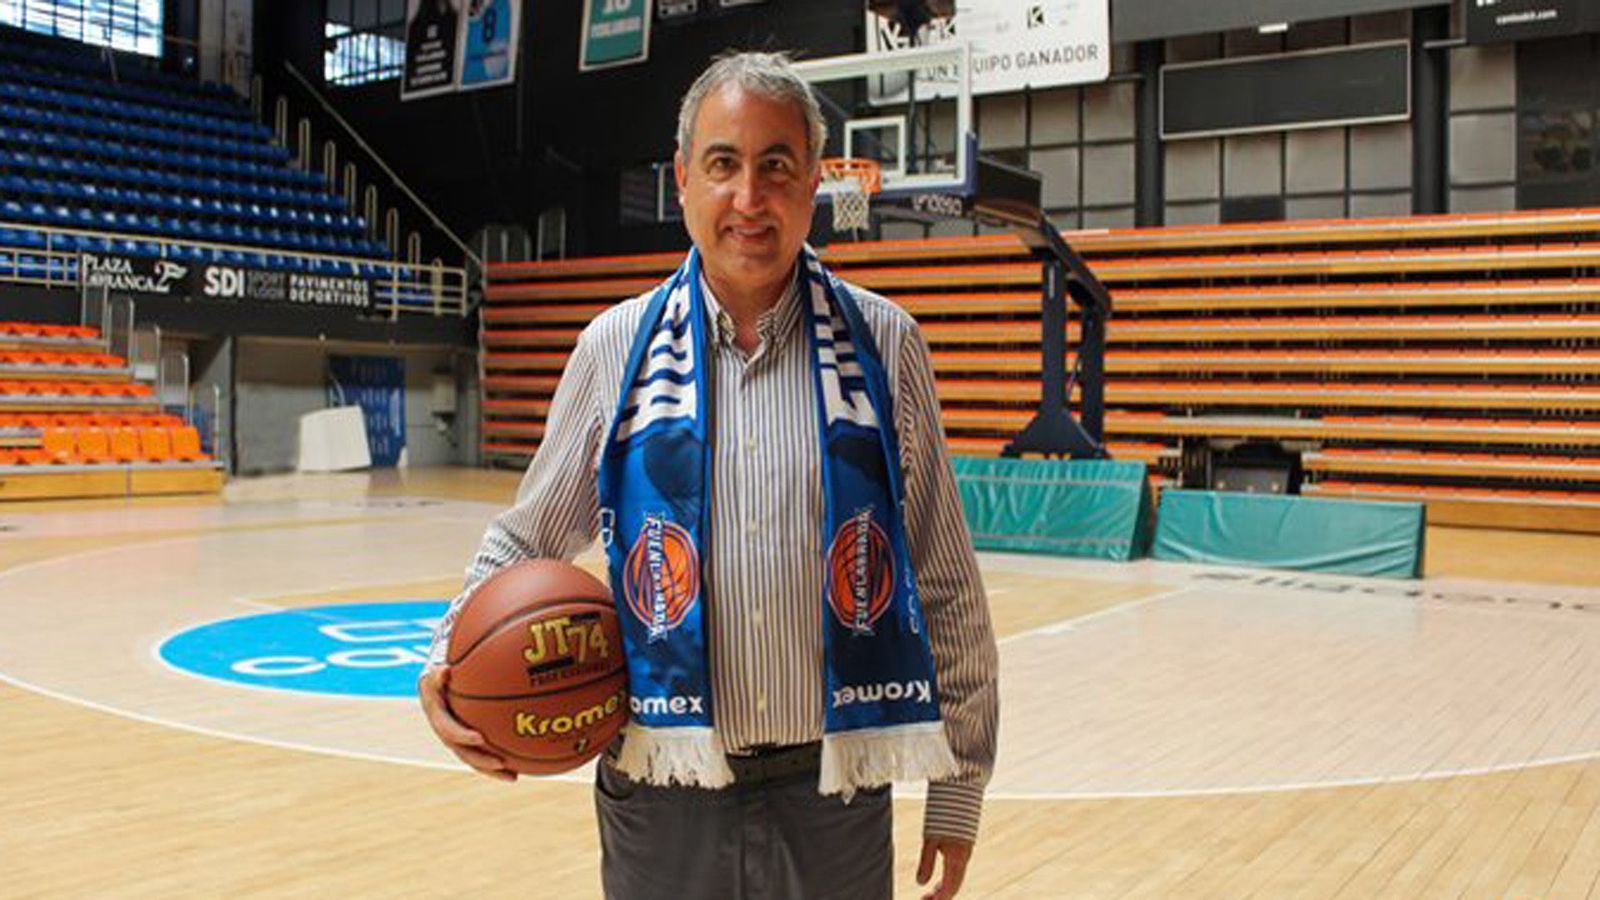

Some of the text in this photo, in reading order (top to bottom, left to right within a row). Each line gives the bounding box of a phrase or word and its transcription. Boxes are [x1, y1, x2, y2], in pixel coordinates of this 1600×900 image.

[927, 44, 1099, 80] UN EUIPO GANADOR
[83, 253, 132, 275] PLAZA
[204, 266, 245, 298] SDI
[290, 274, 368, 292] PAVIMENTOS
[290, 289, 369, 307] DEPORTIVOS
[523, 617, 609, 664] JT74
[629, 695, 704, 716] omex
[832, 680, 932, 708] Kromex
